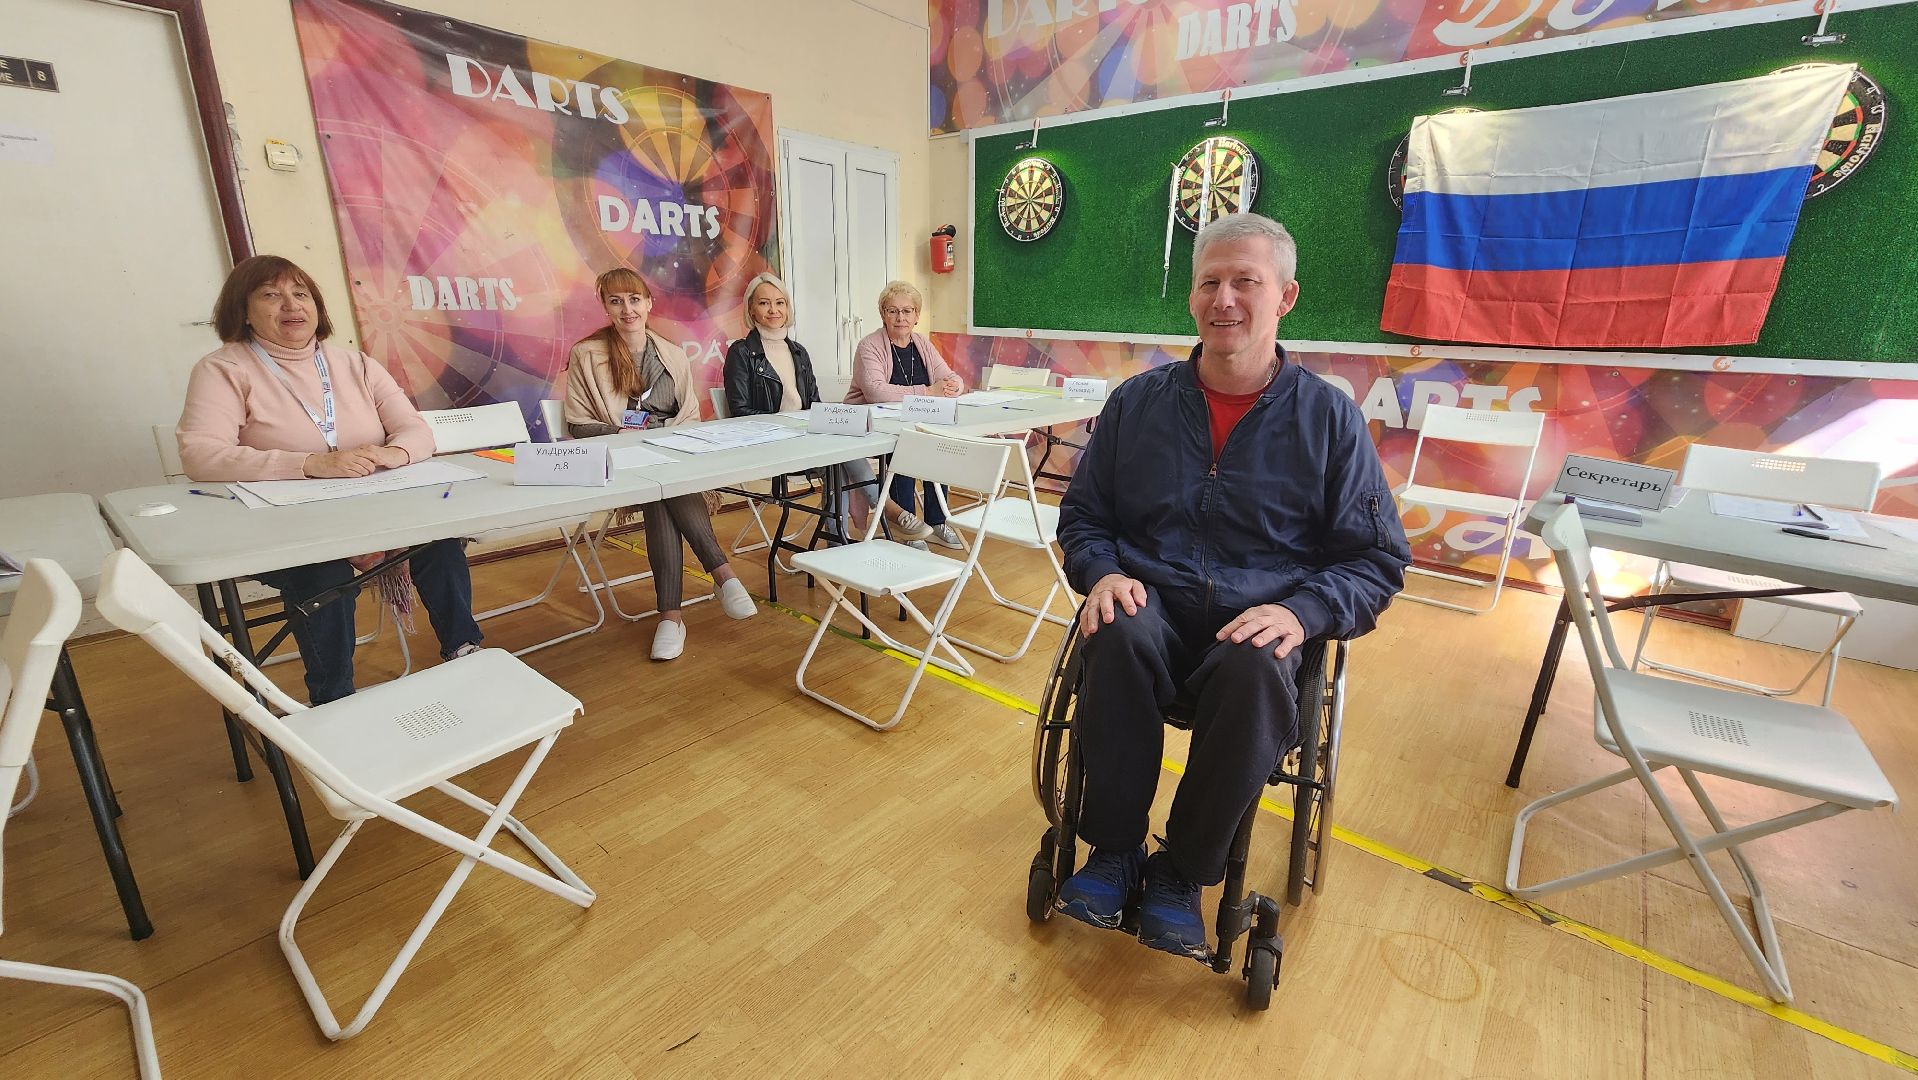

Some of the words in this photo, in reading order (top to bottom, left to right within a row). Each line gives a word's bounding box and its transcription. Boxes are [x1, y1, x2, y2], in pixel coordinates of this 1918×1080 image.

[1175, 0, 1297, 60] DARTS
[36, 70, 47, 82] 8
[445, 53, 630, 125] DARTS
[597, 195, 721, 240] DARTS
[407, 275, 517, 312] DARTS
[536, 446, 588, 457] Ул.Дружбы
[553, 460, 569, 472] д.8
[1566, 466, 1662, 492] Секретарь
